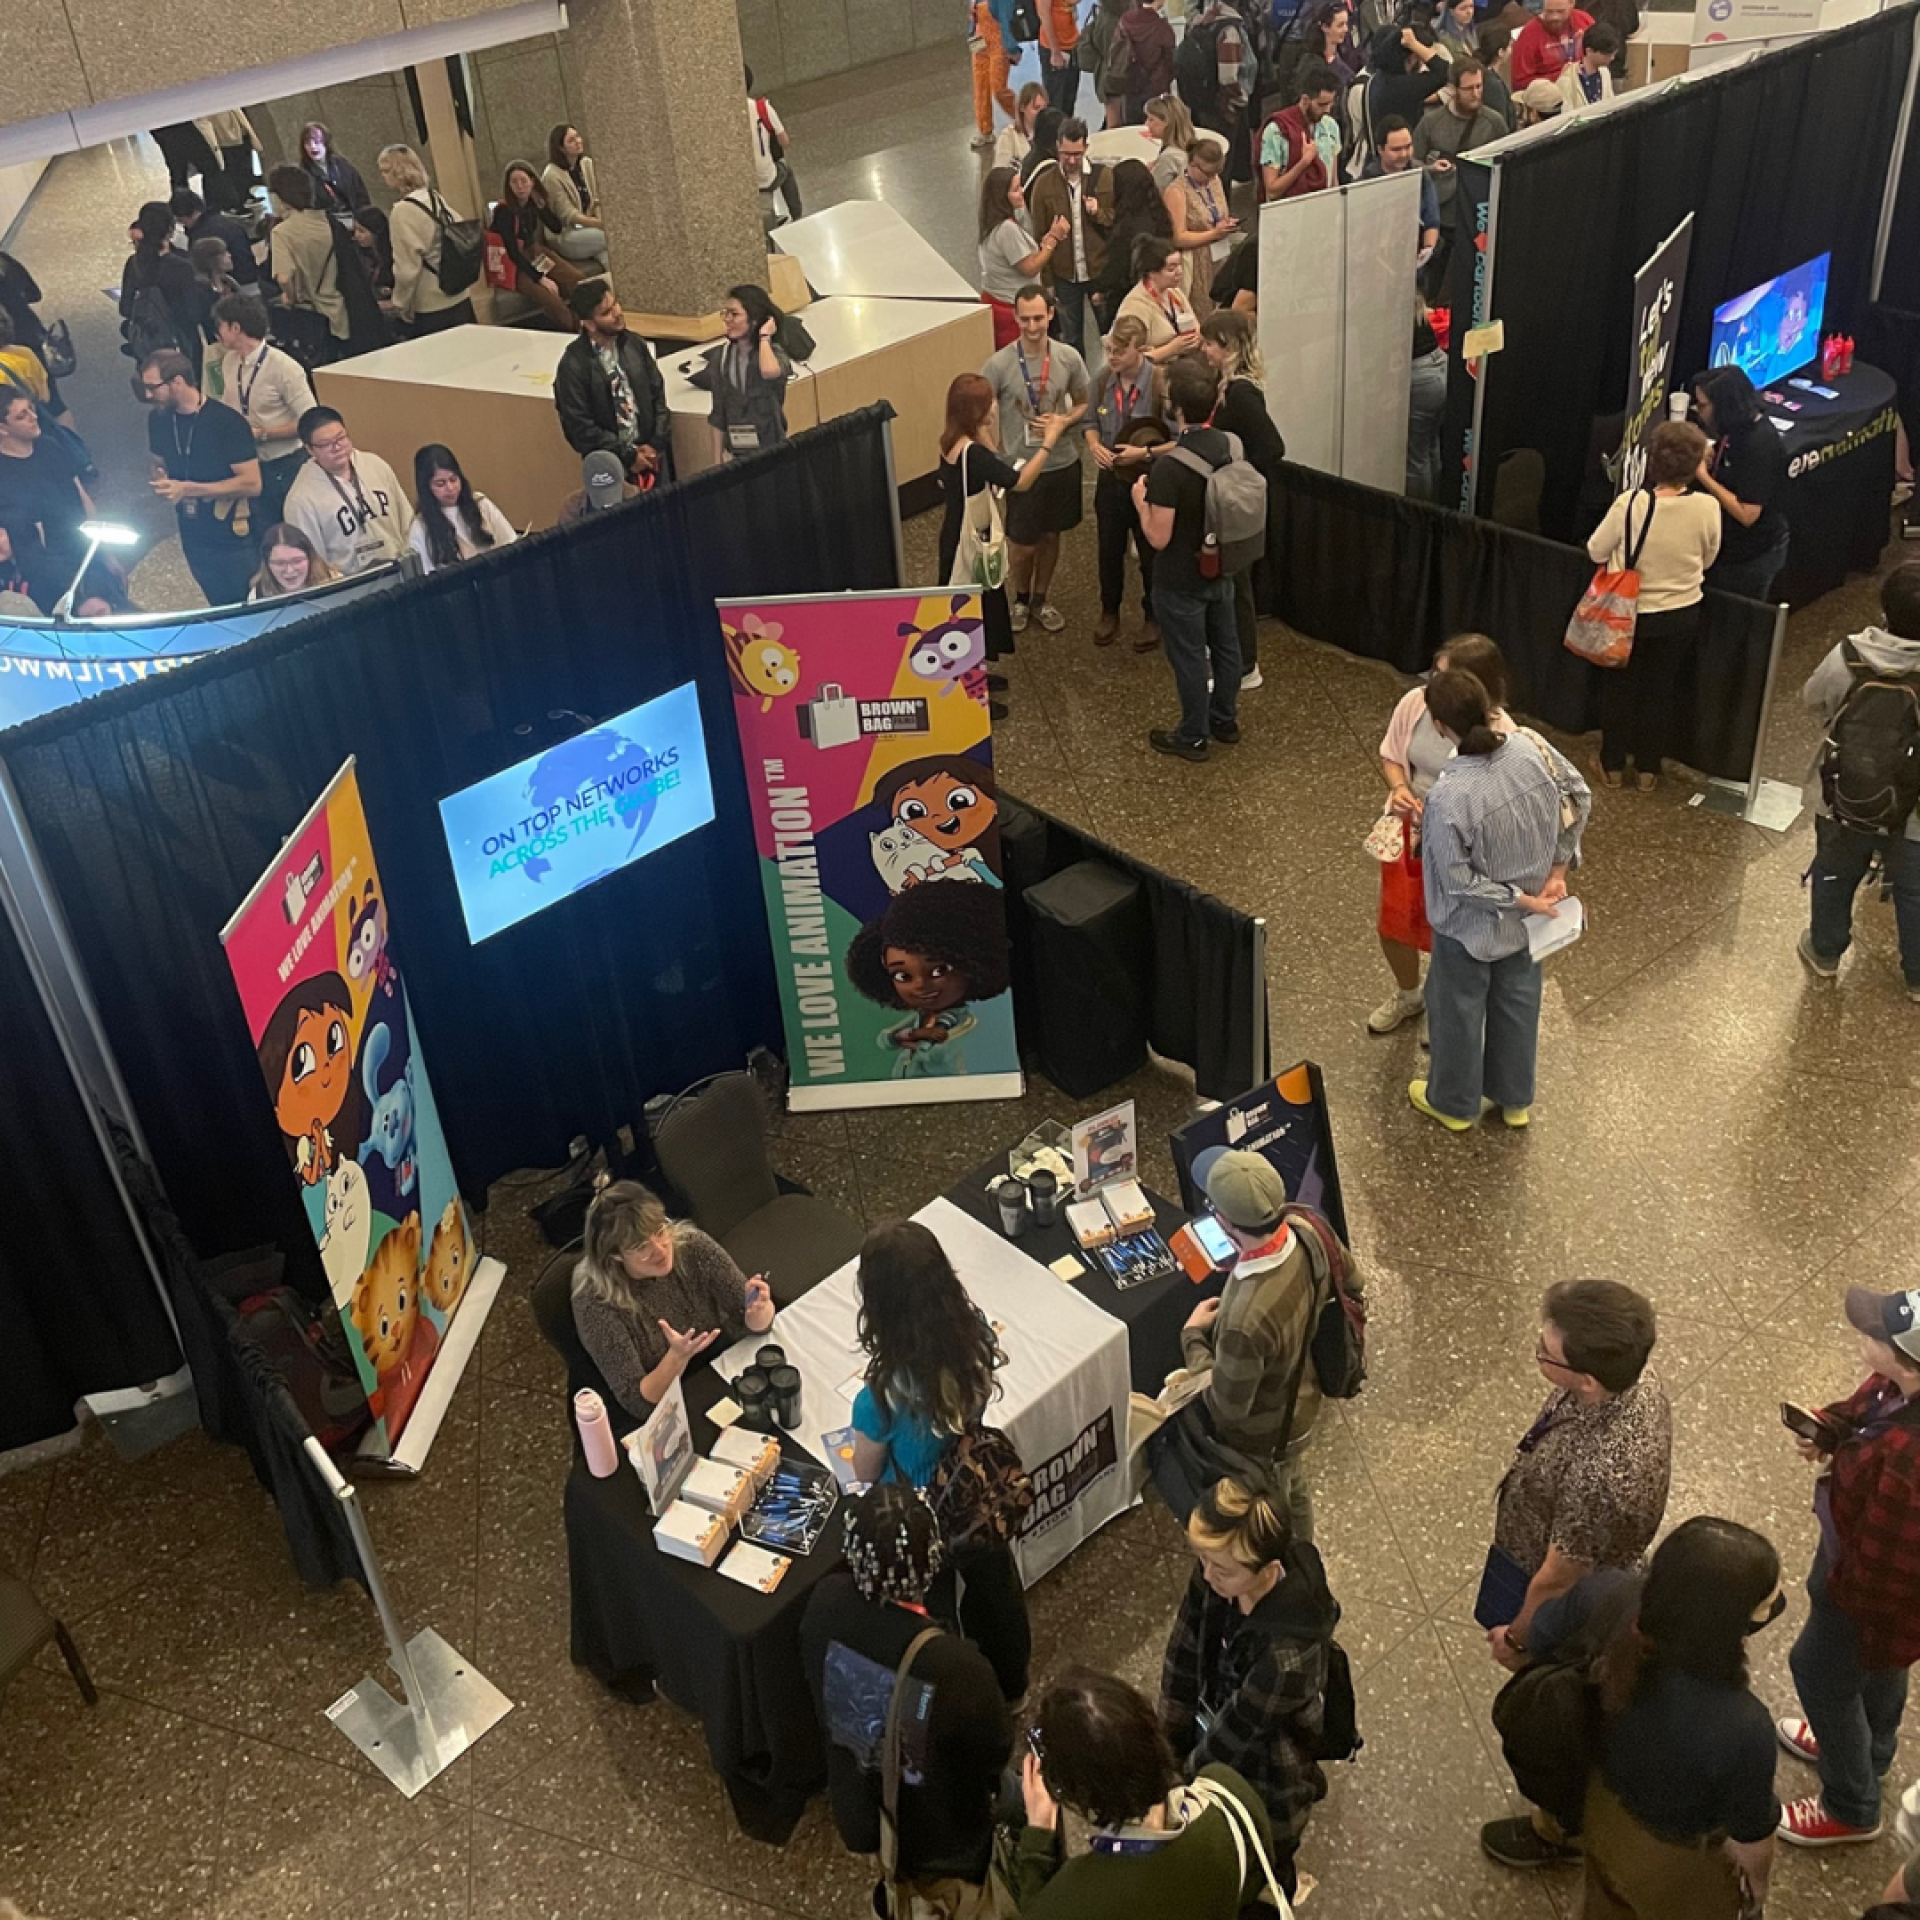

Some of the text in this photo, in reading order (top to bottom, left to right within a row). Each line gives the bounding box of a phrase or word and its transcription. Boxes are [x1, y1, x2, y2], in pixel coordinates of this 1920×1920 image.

[337, 490, 389, 537] GAP
[860, 700, 917, 717] BROWN
[863, 717, 892, 732] BAG
[481, 746, 680, 856] ON TOP NETWORKS
[489, 768, 682, 878] ACROSS THE GLOBE!
[767, 786, 830, 955] ANIMATION
[793, 960, 840, 1028] LOVE
[804, 1032, 846, 1078] WE
[1032, 1425, 1098, 1495] ROWN
